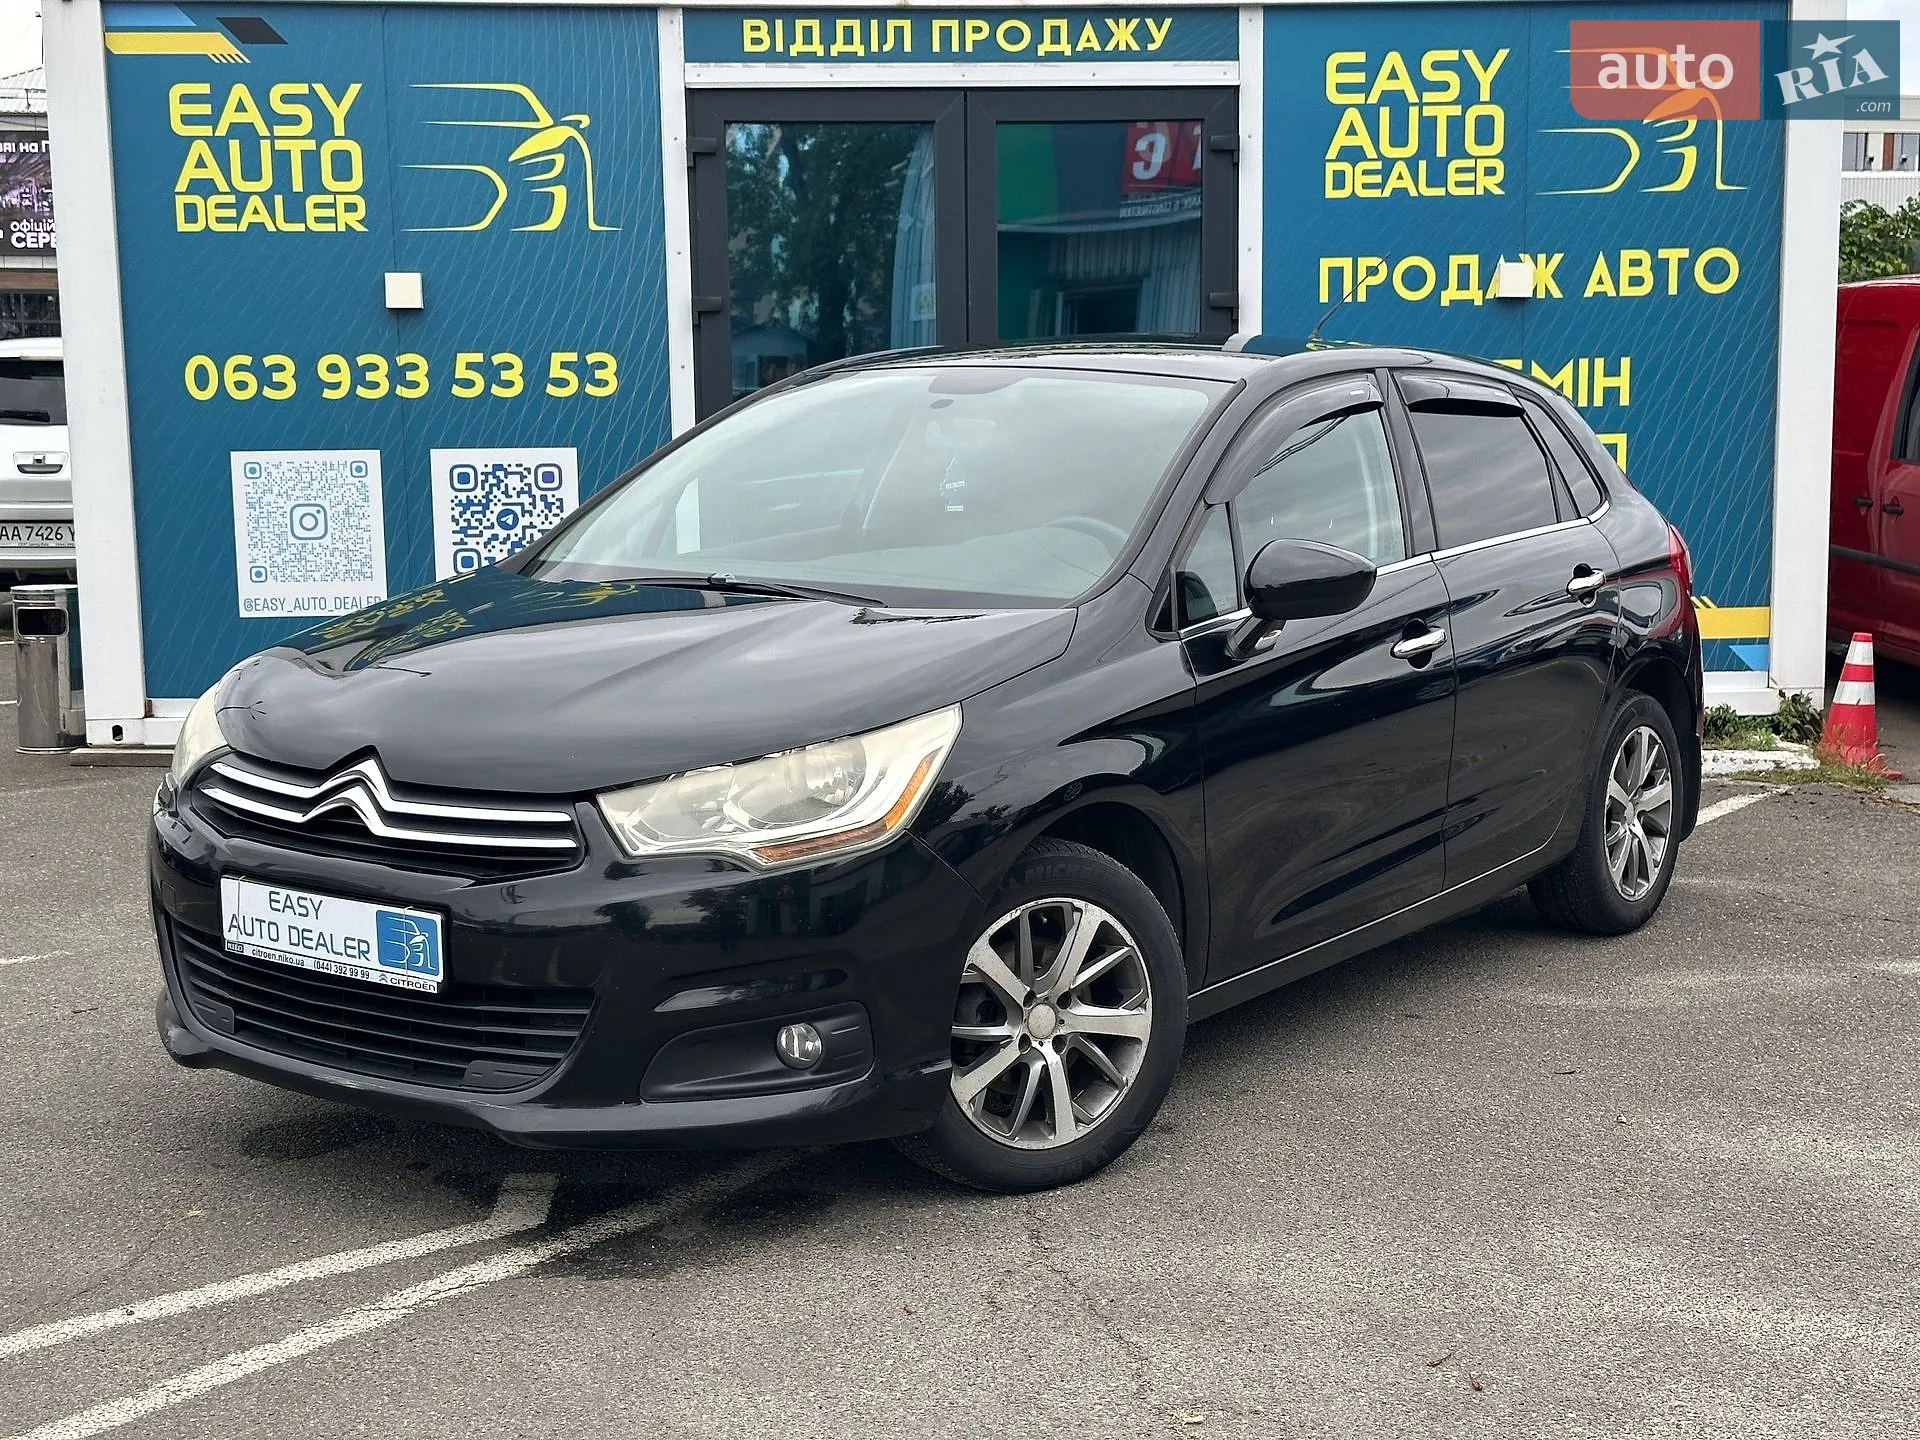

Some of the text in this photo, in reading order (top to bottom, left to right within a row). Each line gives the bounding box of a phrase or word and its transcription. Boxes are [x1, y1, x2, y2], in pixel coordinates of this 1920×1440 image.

[742, 17, 1173, 57] ВІДДІЛ ПРОДАЖУ
[1325, 48, 1510, 105] EASY
[168, 82, 363, 137] EASY
[1325, 104, 1505, 160] AUTO
[175, 139, 365, 193] AUTO
[1324, 159, 1506, 199] DEALER
[10, 218, 56, 233] офіцій
[175, 194, 368, 233] DEALER
[1584, 246, 1741, 298] АВТО
[184, 352, 619, 400] 063 933 53 53
[1493, 356, 1631, 408] МІН
[0, 526, 22, 541] AA
[25, 526, 64, 541] 7426
[268, 890, 324, 920] EASY
[227, 913, 371, 962] AUTO DEALER
[251, 947, 305, 968] citroen.niko.ua
[313, 959, 333, 974] (044)
[334, 963, 348, 977] 392
[349, 965, 359, 978] 99
[360, 967, 370, 980] 99
